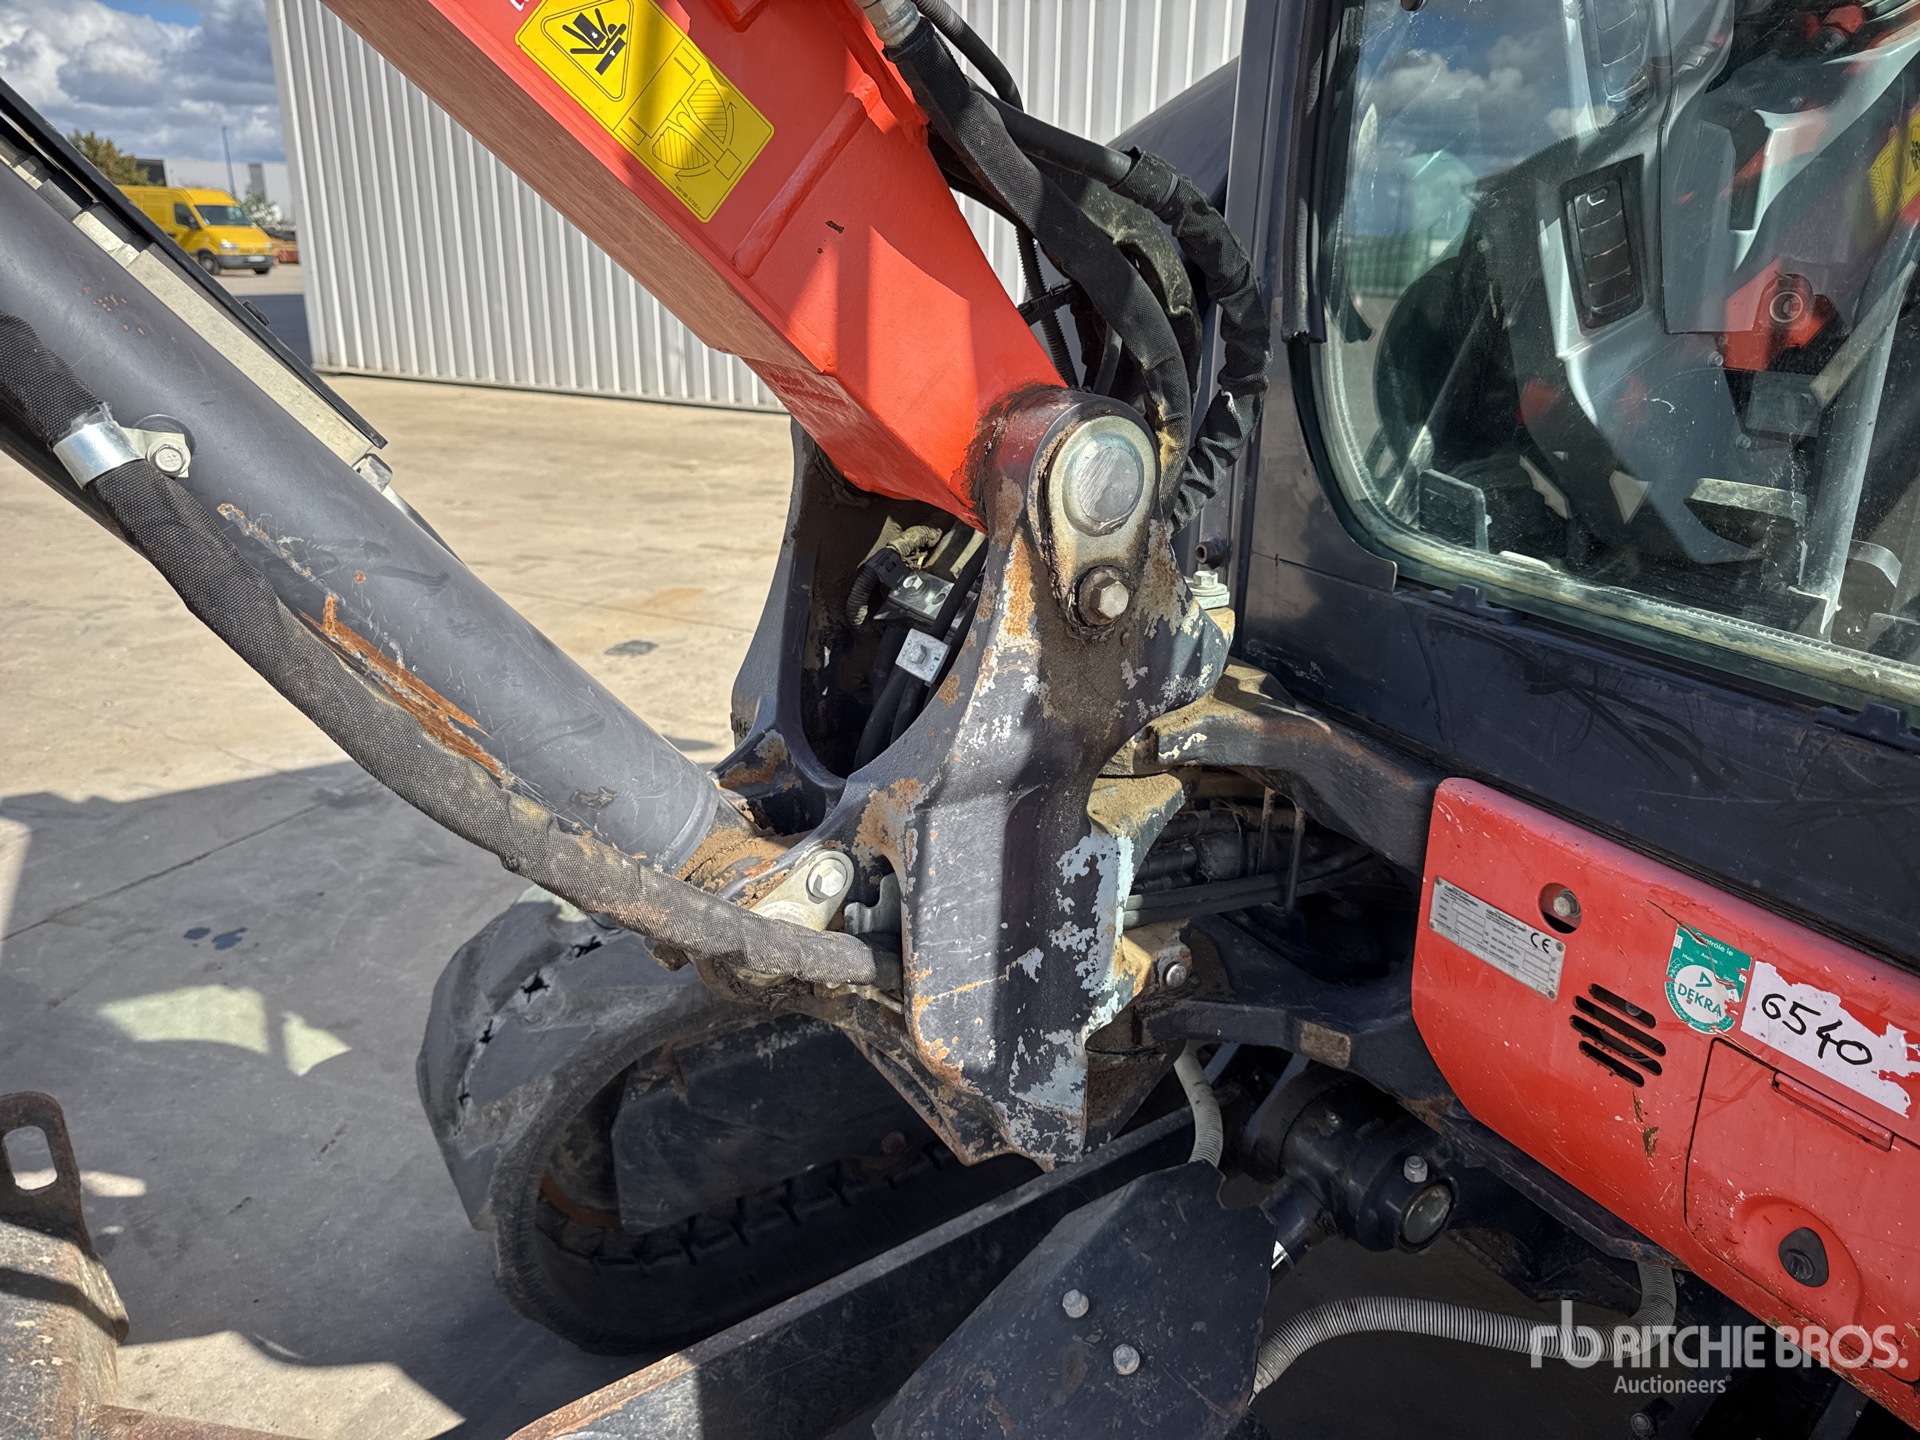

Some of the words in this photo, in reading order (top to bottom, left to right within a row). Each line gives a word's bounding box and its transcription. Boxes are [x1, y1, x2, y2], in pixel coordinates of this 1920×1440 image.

[1530, 932, 1551, 954] CE
[1678, 983, 1722, 1018] DEKRA
[1761, 993, 1873, 1066] 6540
